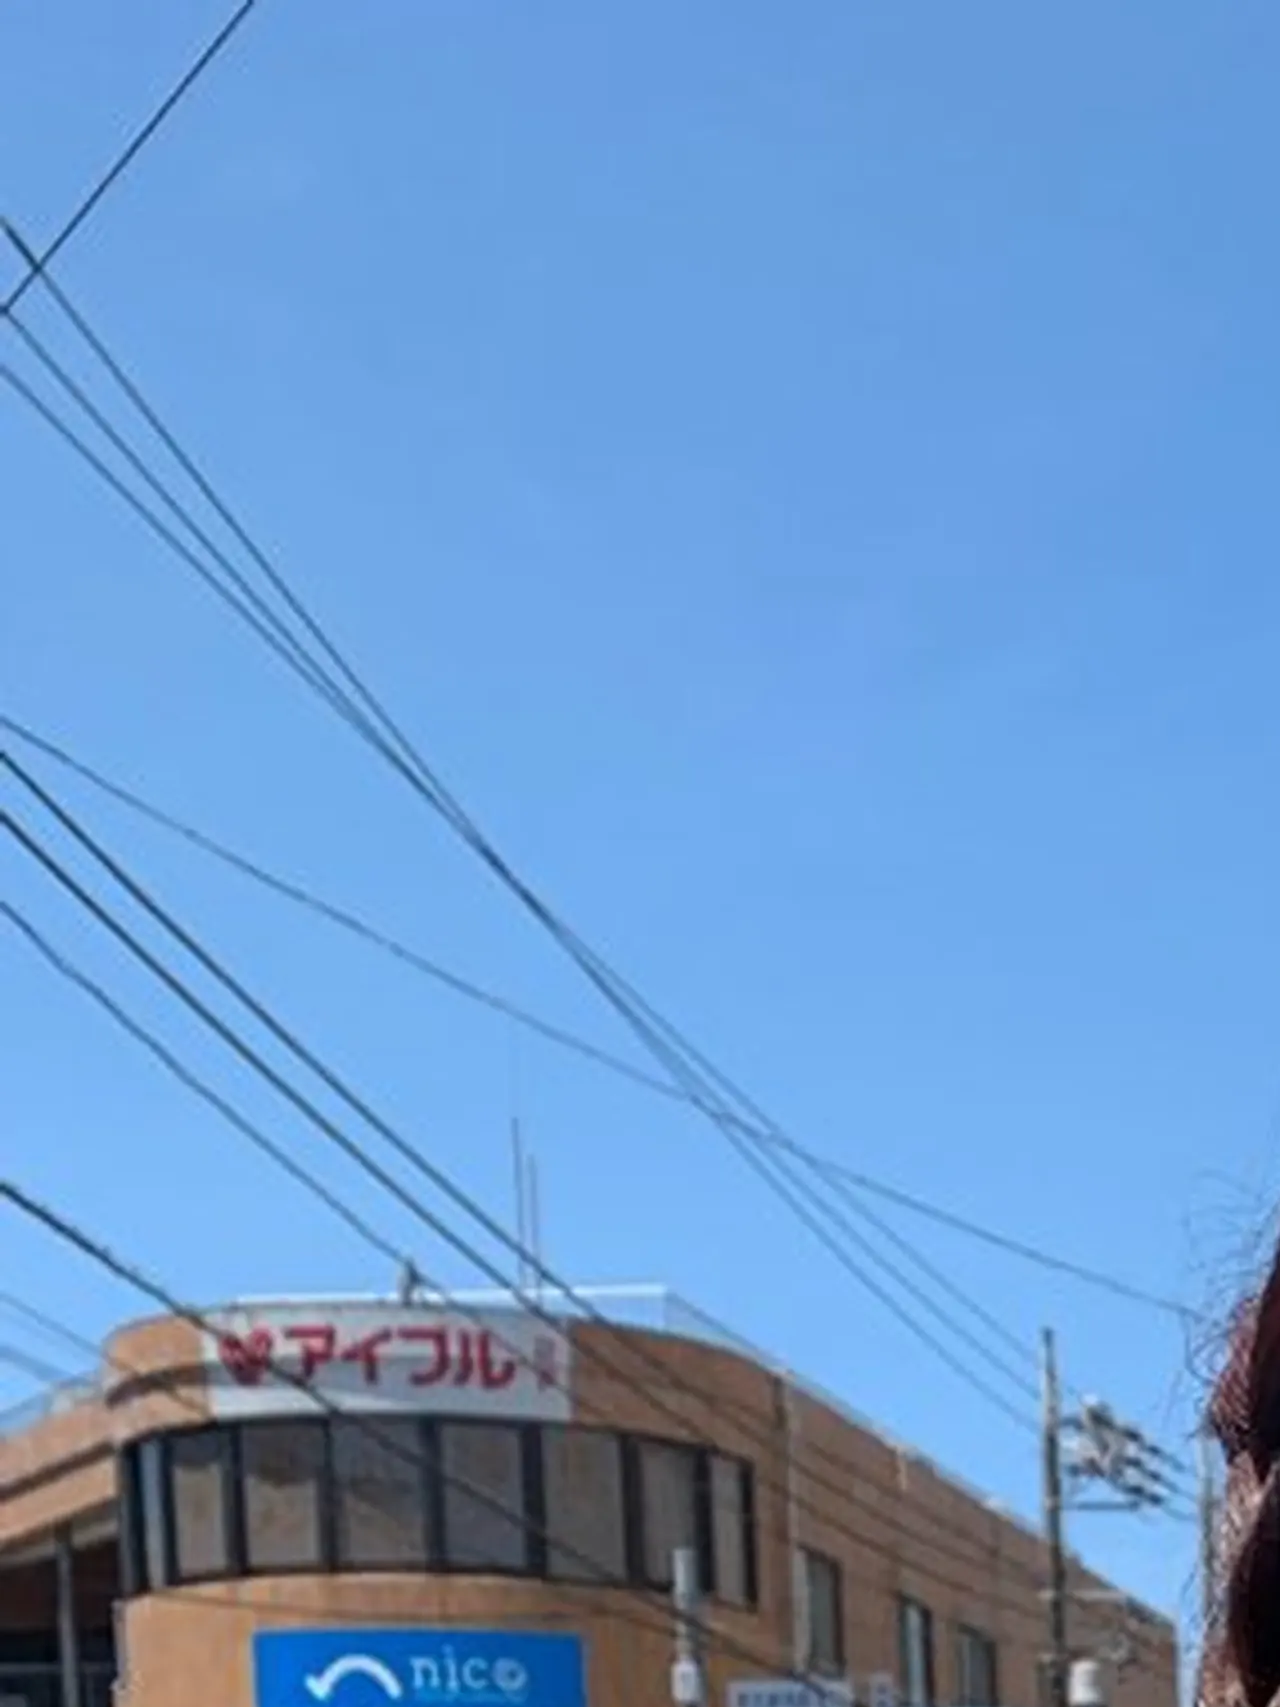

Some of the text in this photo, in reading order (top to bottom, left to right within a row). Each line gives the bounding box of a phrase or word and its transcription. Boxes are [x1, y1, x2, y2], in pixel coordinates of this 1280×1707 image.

[284, 1323, 516, 1390] アイフル
[411, 1645, 528, 1695] nico
